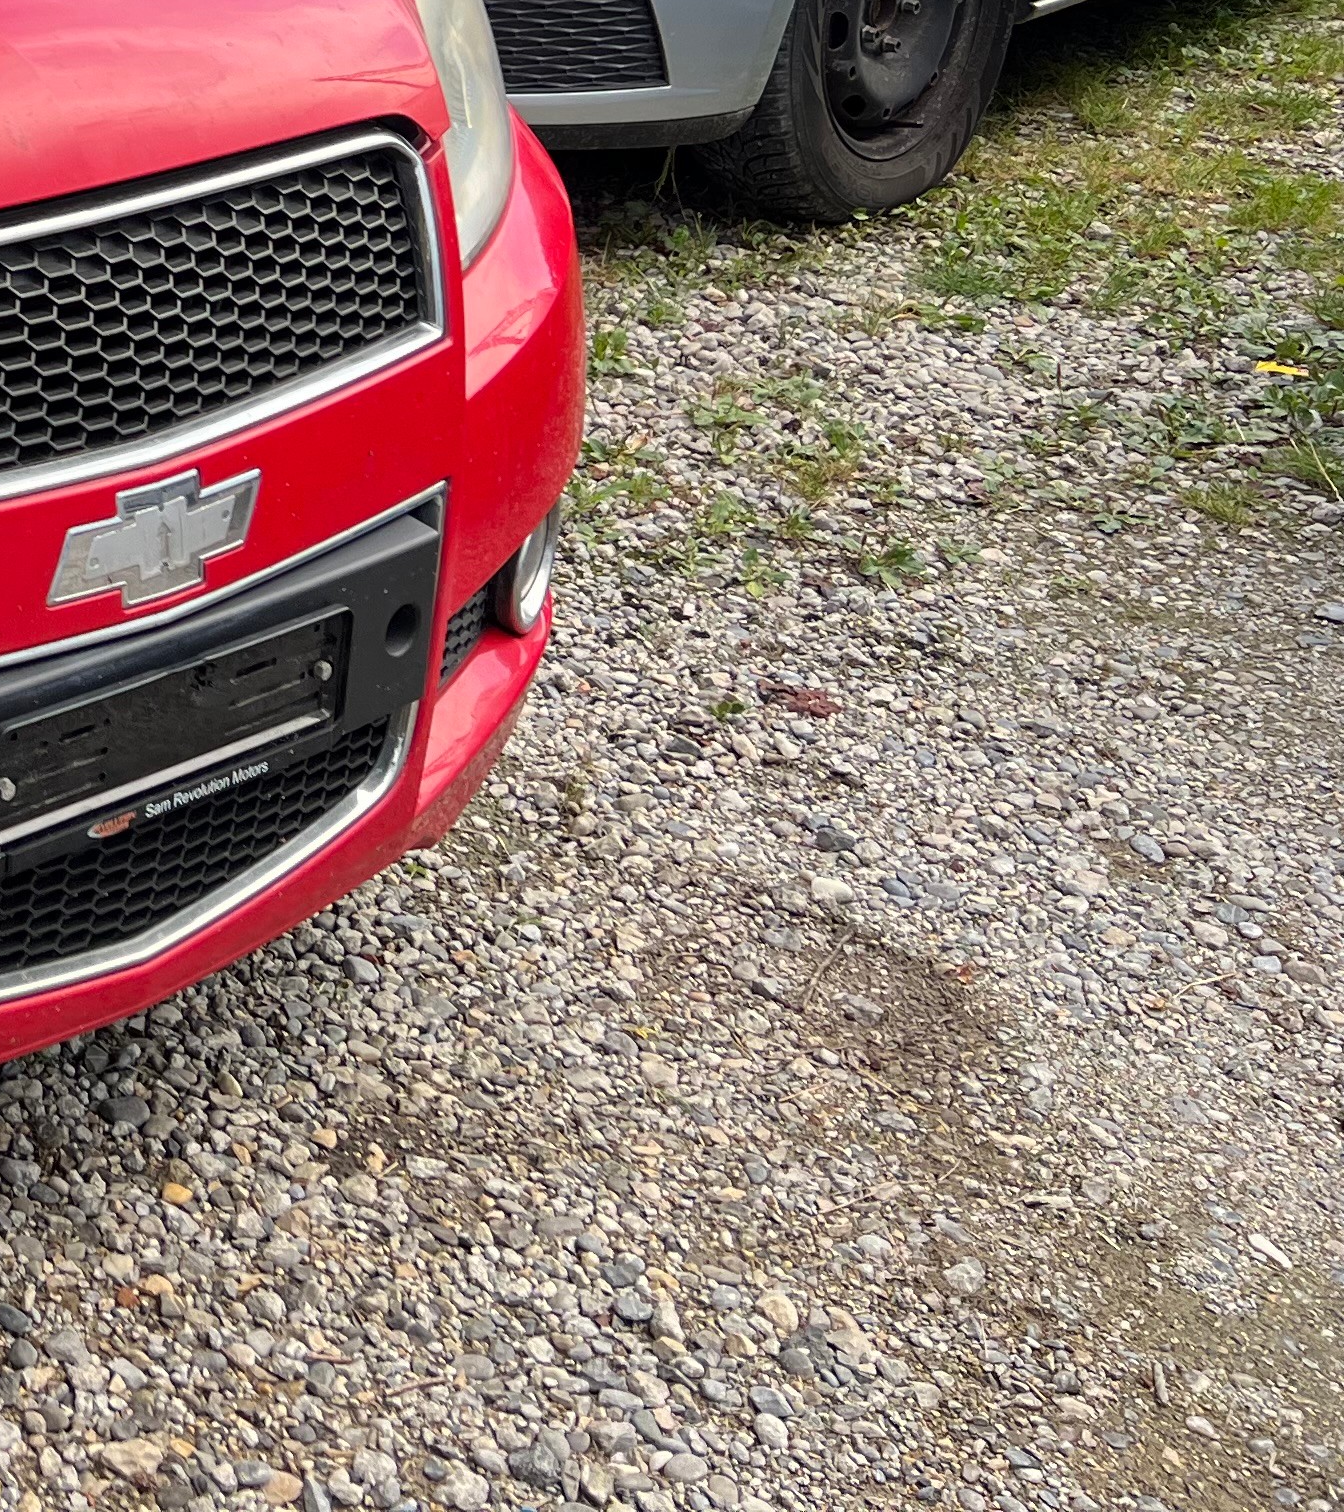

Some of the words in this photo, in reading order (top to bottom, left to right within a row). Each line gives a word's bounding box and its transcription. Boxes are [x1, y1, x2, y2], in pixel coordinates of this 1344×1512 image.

[145, 798, 171, 818] Sam
[173, 776, 231, 807] Revolution
[232, 761, 269, 785] Motors
